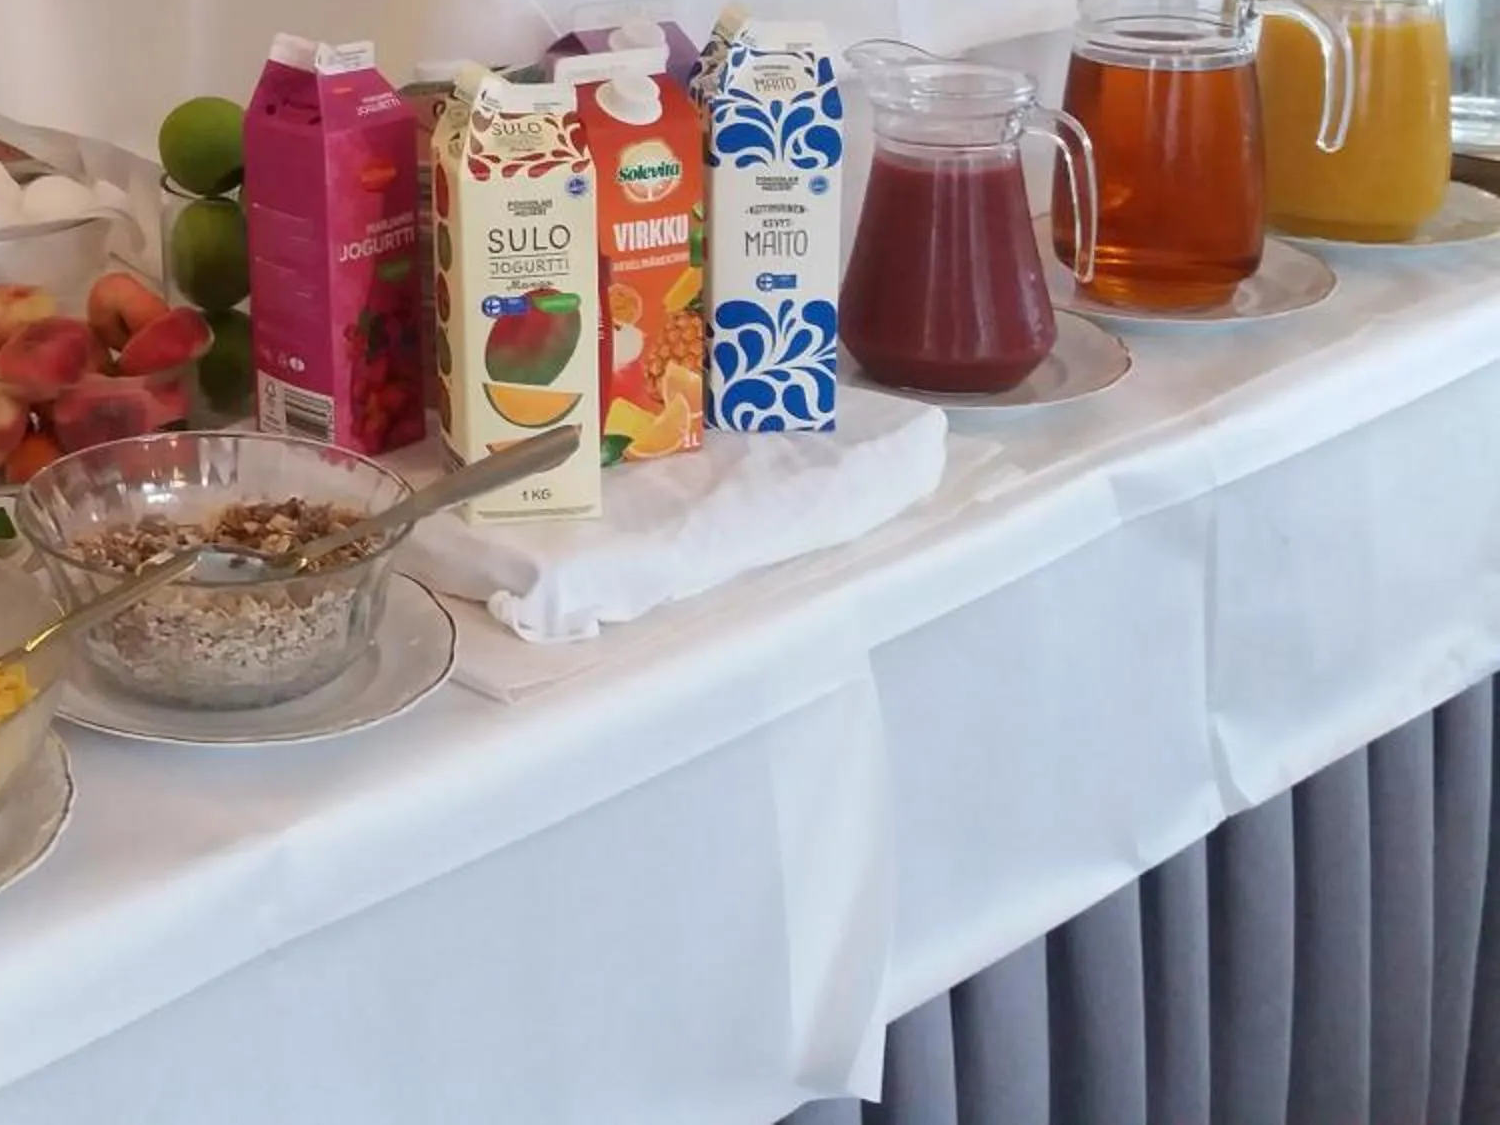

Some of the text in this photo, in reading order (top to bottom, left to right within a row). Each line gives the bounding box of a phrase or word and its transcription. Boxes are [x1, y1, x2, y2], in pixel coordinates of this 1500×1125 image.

[753, 77, 797, 92] MAITO
[492, 121, 542, 136] SULO
[618, 160, 680, 182] Solevita
[487, 224, 571, 254] SULO
[613, 214, 689, 252] VIRKKU
[744, 229, 809, 257] MAITO
[339, 226, 415, 263] JOGURTTI
[489, 258, 570, 275] JOGURTTI
[531, 489, 552, 502] KG
